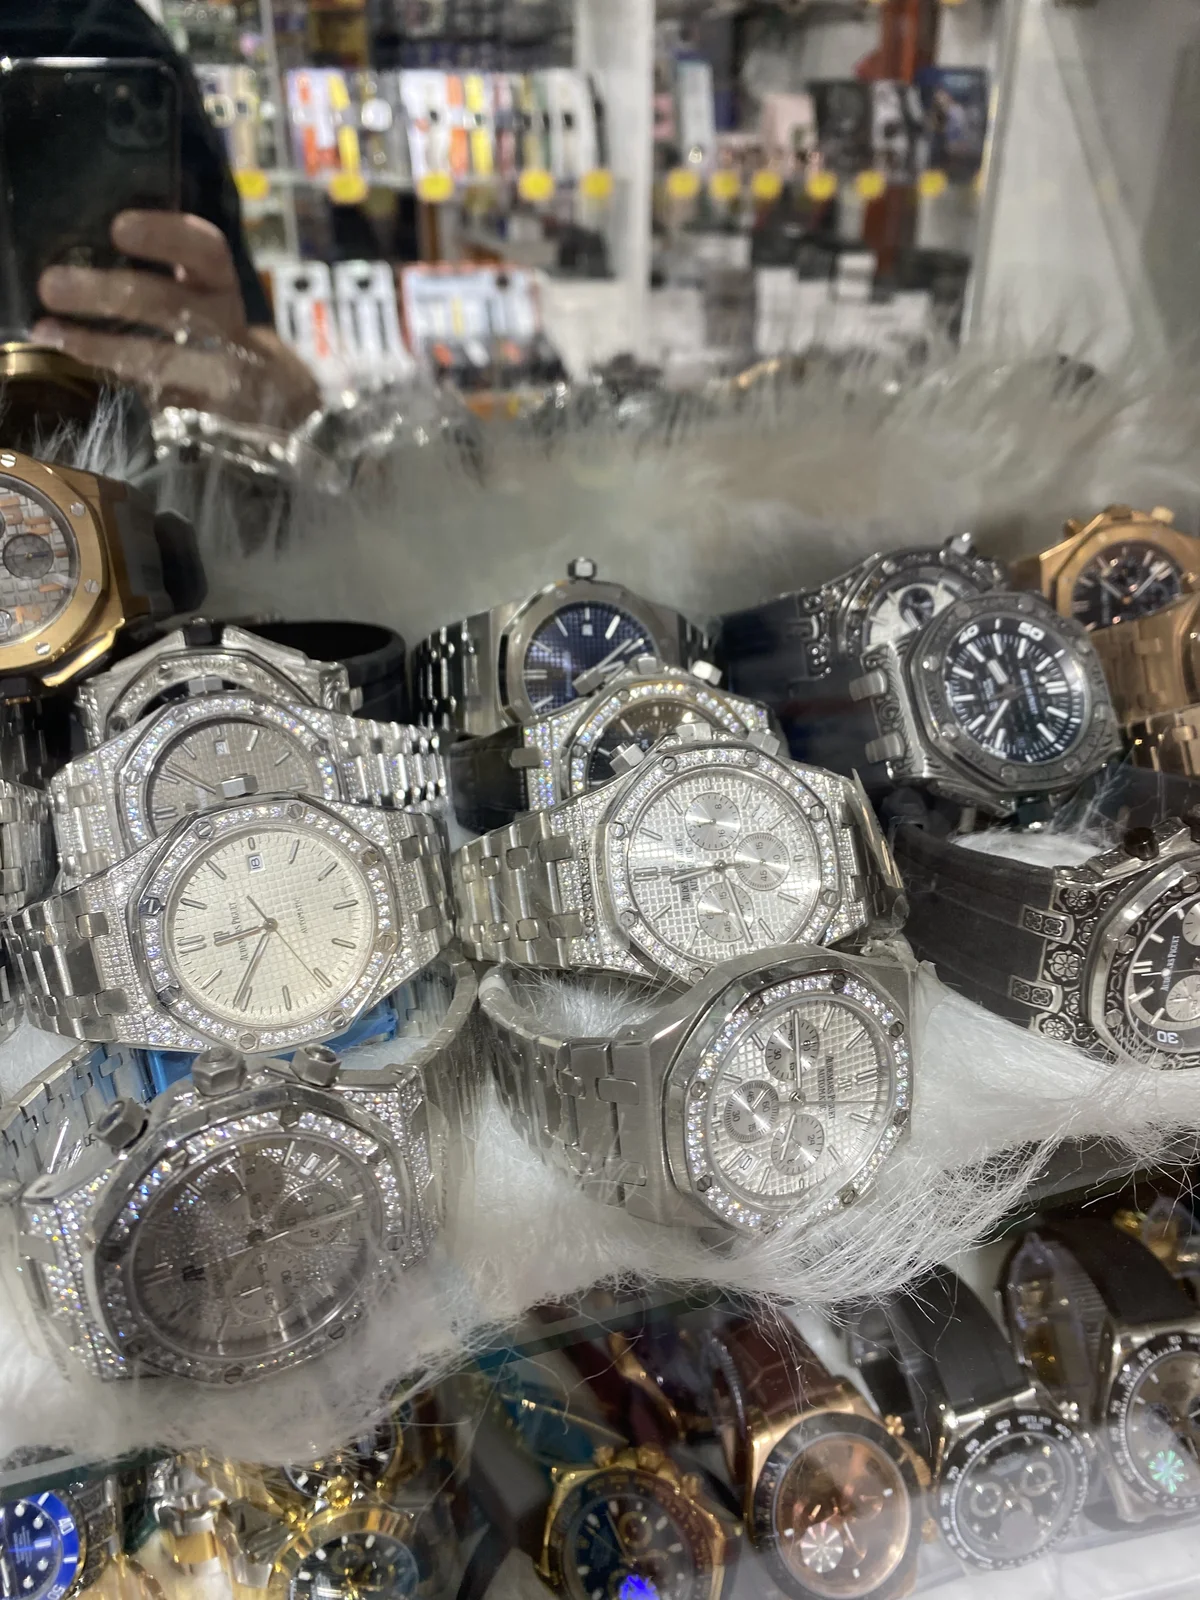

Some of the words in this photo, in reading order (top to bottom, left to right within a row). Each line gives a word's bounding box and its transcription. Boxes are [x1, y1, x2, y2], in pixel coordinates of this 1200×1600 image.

[958, 624, 979, 645] 40
[1017, 621, 1046, 642] 50
[717, 829, 727, 839] 16
[755, 841, 765, 850] 15
[760, 870, 769, 882] 45
[724, 920, 733, 933] 45
[1156, 1030, 1179, 1044] 30
[773, 1048, 782, 1061] 30
[746, 1090, 755, 1103] 45
[762, 1100, 771, 1113] 60
[732, 1109, 741, 1122] 30
[748, 1122, 757, 1133] 15
[807, 1134, 816, 1146] 24
[58, 1517, 75, 1536] 40
[47, 1584, 67, 1600] 50
